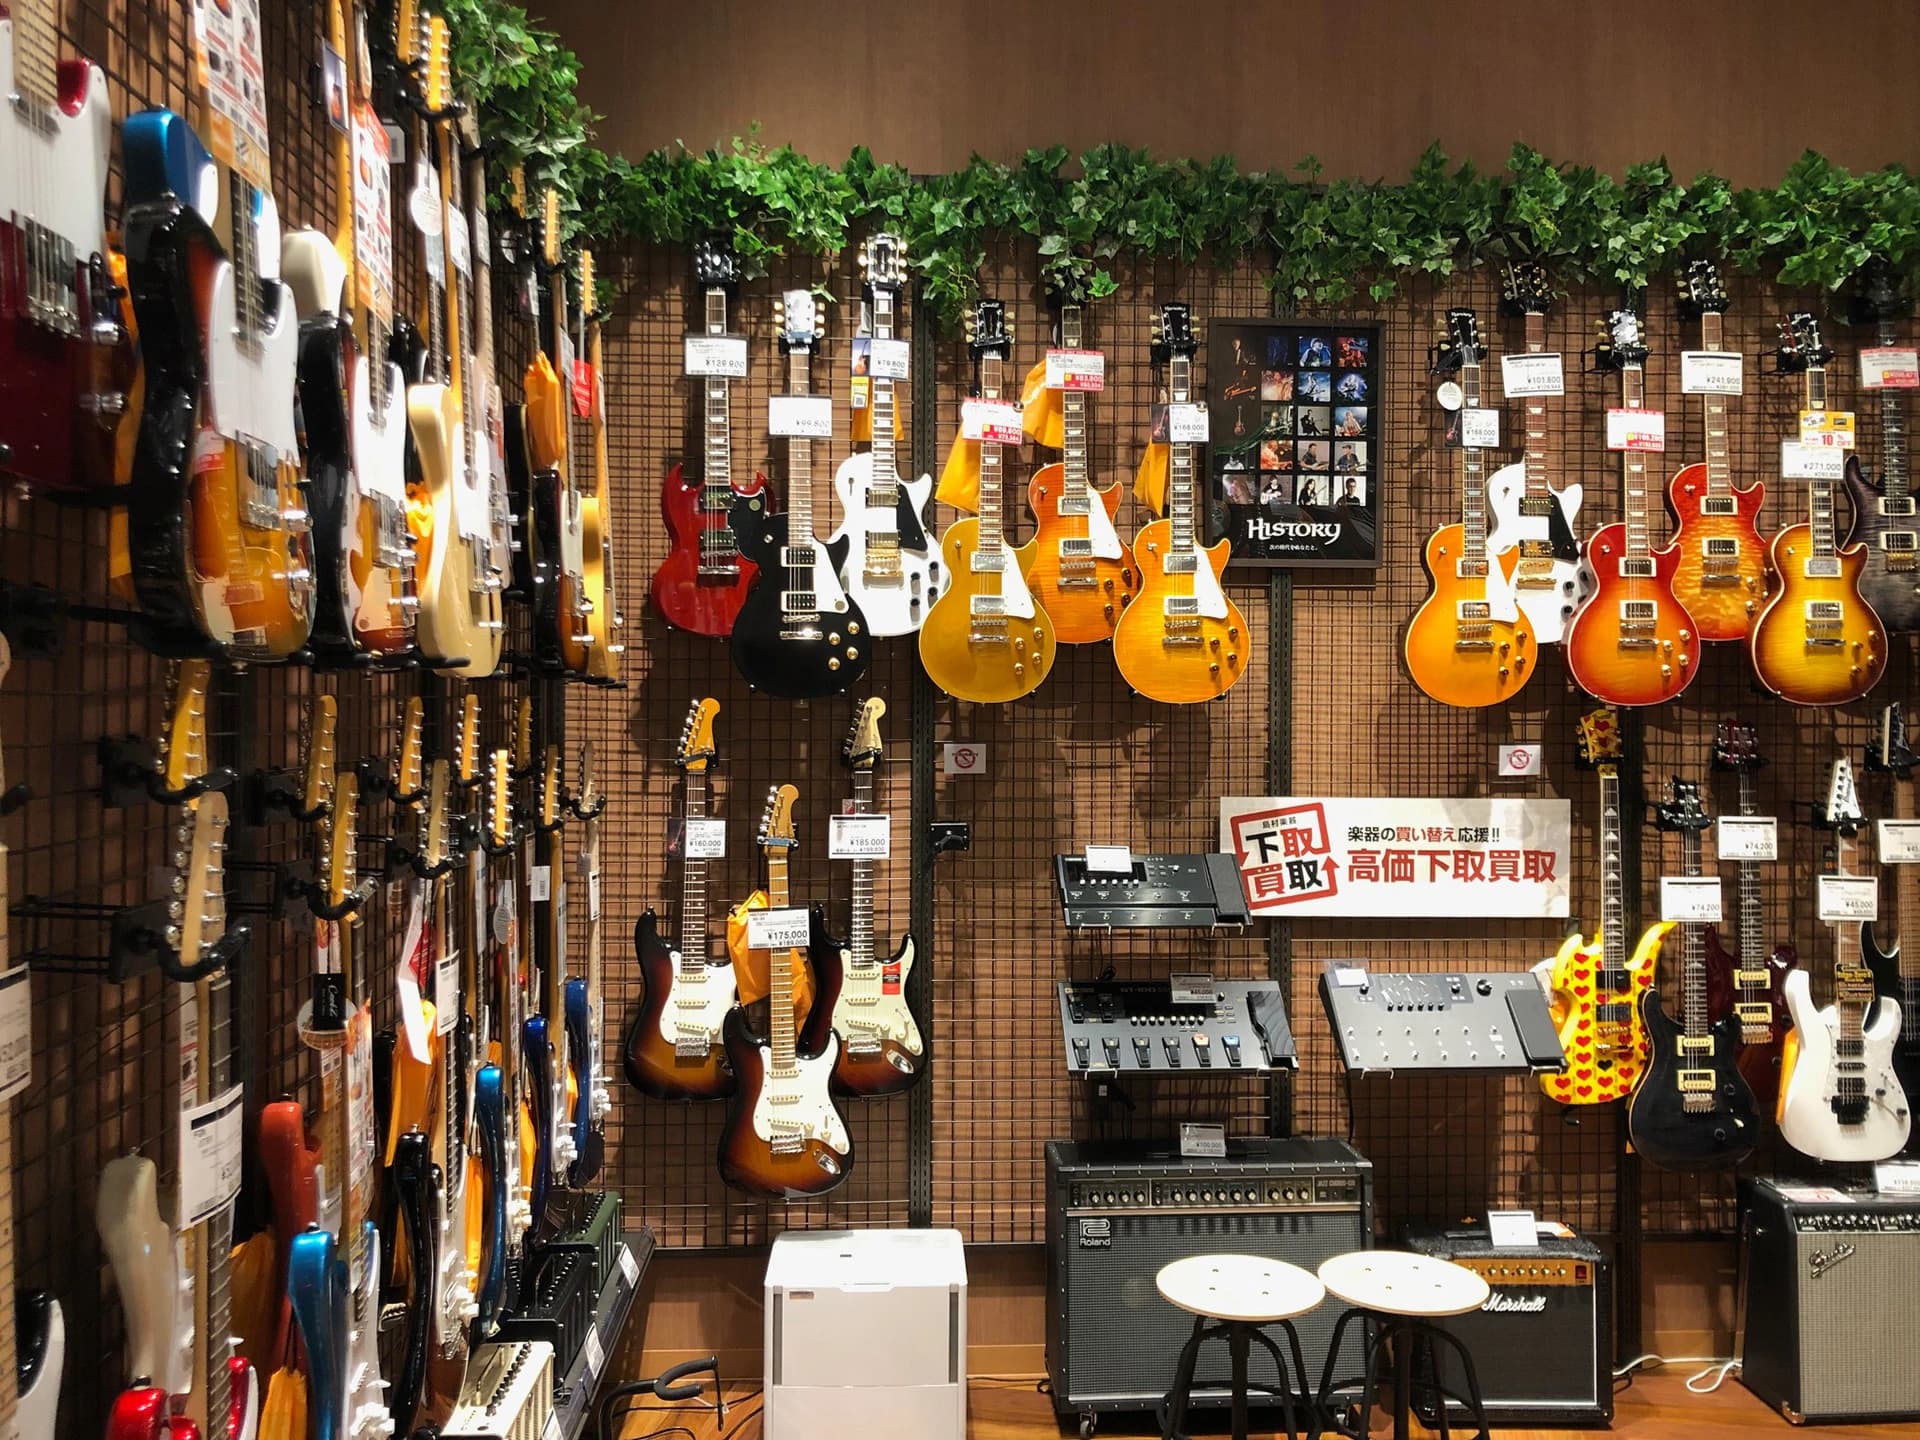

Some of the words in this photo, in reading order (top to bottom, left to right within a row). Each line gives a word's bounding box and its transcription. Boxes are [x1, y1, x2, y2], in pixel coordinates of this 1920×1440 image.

[1822, 434, 1834, 446] 10
[1246, 517, 1341, 545] HISTORY
[850, 838, 886, 846] ¥185,000
[1347, 848, 1557, 883] 高価下取買取
[1242, 859, 1323, 898] 買取
[767, 930, 808, 940] ¥175,000
[1079, 1238, 1111, 1247] Roland
[1481, 1292, 1547, 1313] Marshall
